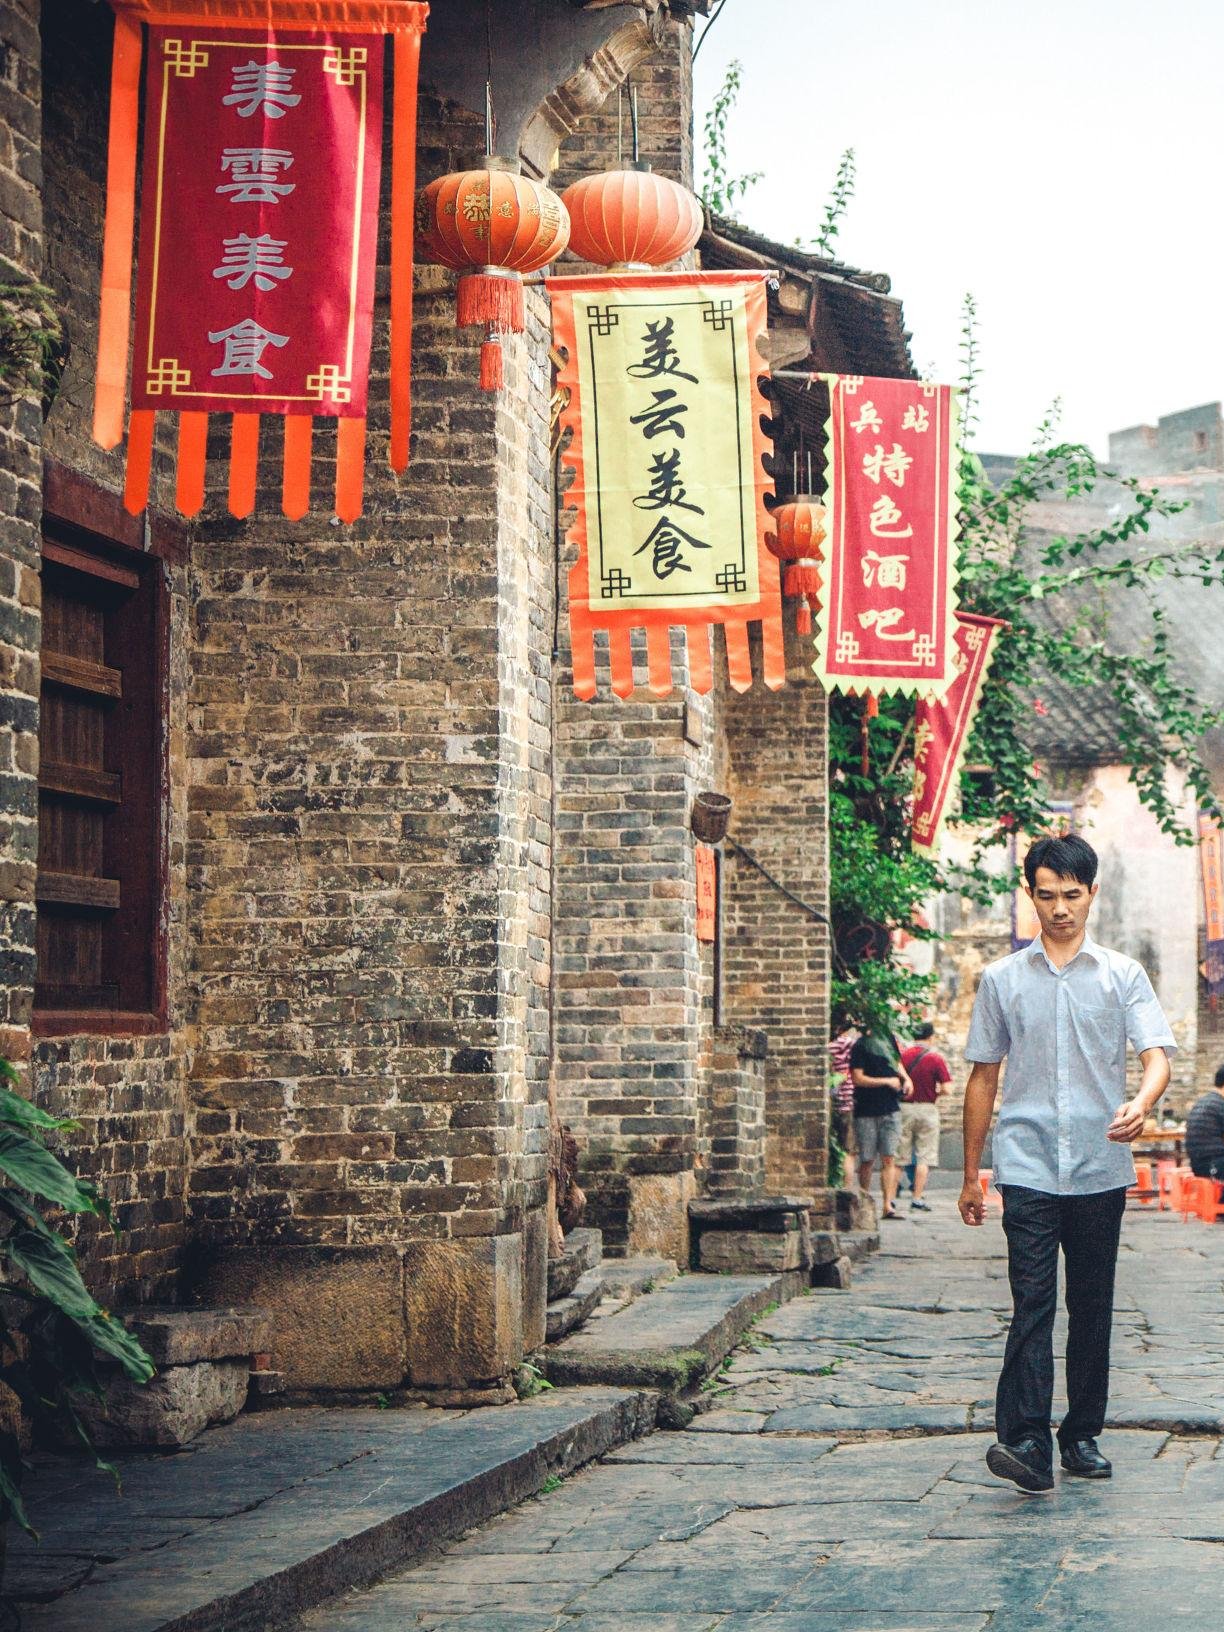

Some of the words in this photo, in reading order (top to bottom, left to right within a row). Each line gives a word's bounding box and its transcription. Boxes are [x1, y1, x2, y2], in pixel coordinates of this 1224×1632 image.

[208, 59, 302, 381] 美雲美食
[625, 316, 713, 580] 美云美食
[856, 443, 918, 644] 特色酒吧
